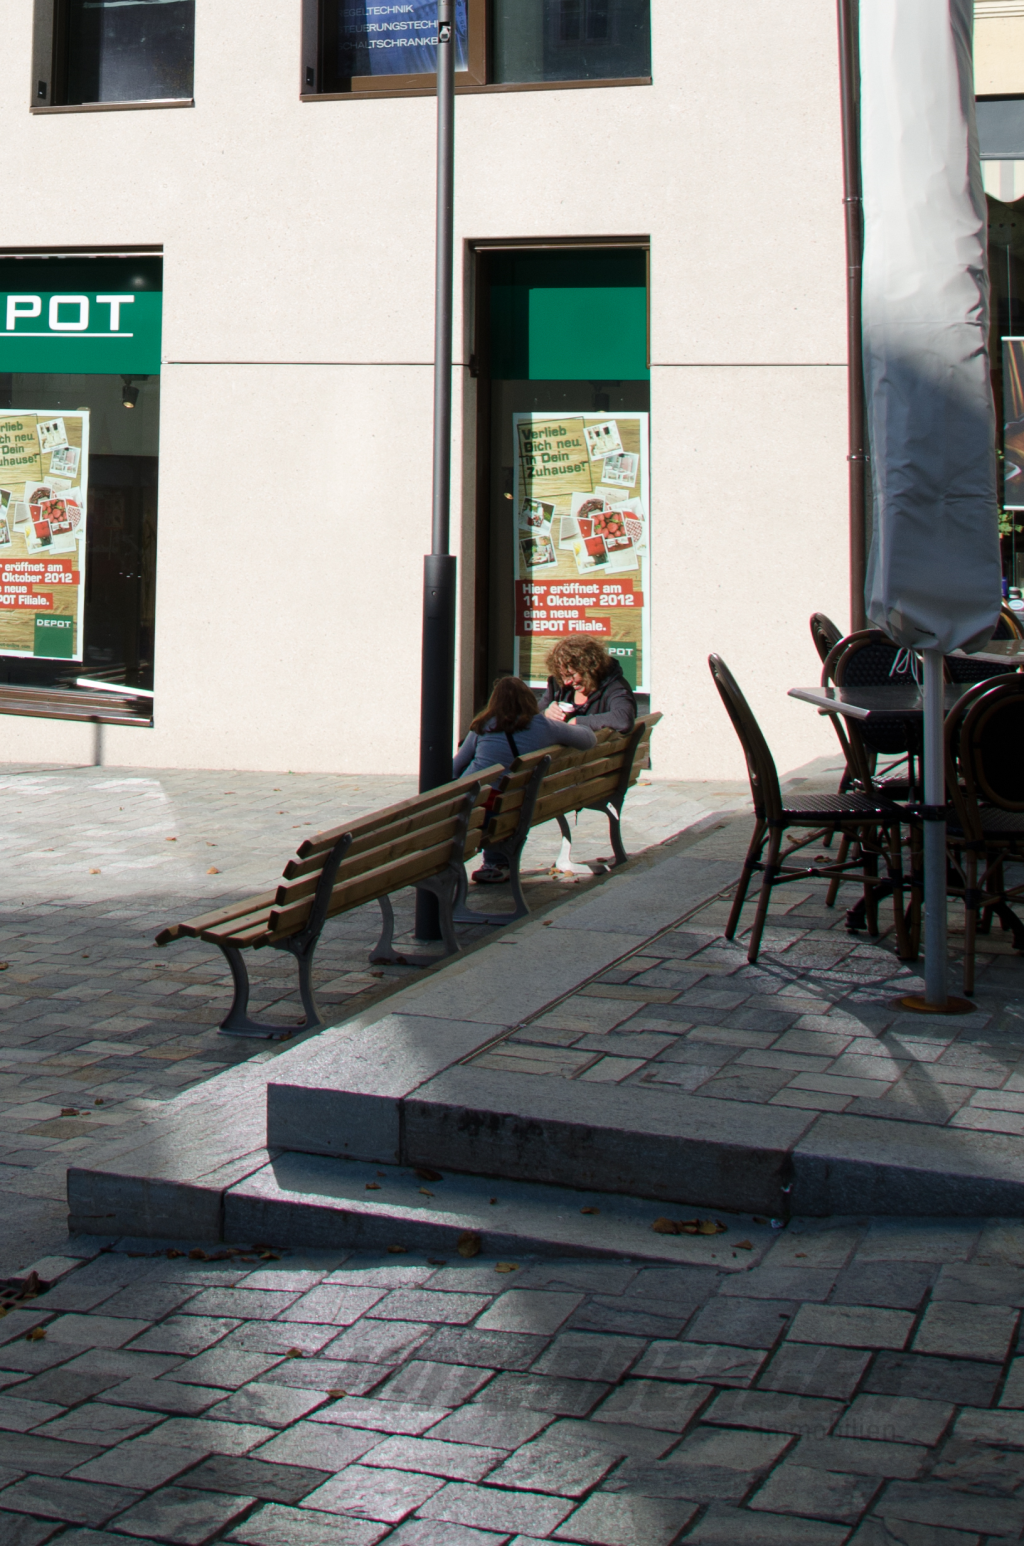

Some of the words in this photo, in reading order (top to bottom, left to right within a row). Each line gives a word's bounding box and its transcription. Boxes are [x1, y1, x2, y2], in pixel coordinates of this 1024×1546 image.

[522, 425, 567, 441] Verlieb
[2, 444, 25, 455] Dein
[525, 439, 552, 452] Dich
[526, 454, 537, 465] in
[541, 452, 569, 464] Dein
[5, 561, 45, 572] eröffnet
[47, 563, 63, 572] am
[2, 572, 42, 583] Oktober
[44, 573, 73, 583] 2012
[4, 584, 28, 594] neue
[522, 583, 547, 595] Hier
[550, 582, 600, 594] eröffnet
[602, 585, 622, 594] am
[18, 594, 50, 606] Filiale.
[523, 595, 543, 606] 11.
[547, 595, 596, 606] Oktober
[599, 595, 634, 606] 2012
[523, 608, 547, 619] eine
[550, 608, 579, 619] neue
[37, 618, 72, 627] DEPOT
[524, 620, 565, 632] DEPOT
[568, 620, 607, 632] Filiale.
[607, 647, 634, 656] POT
